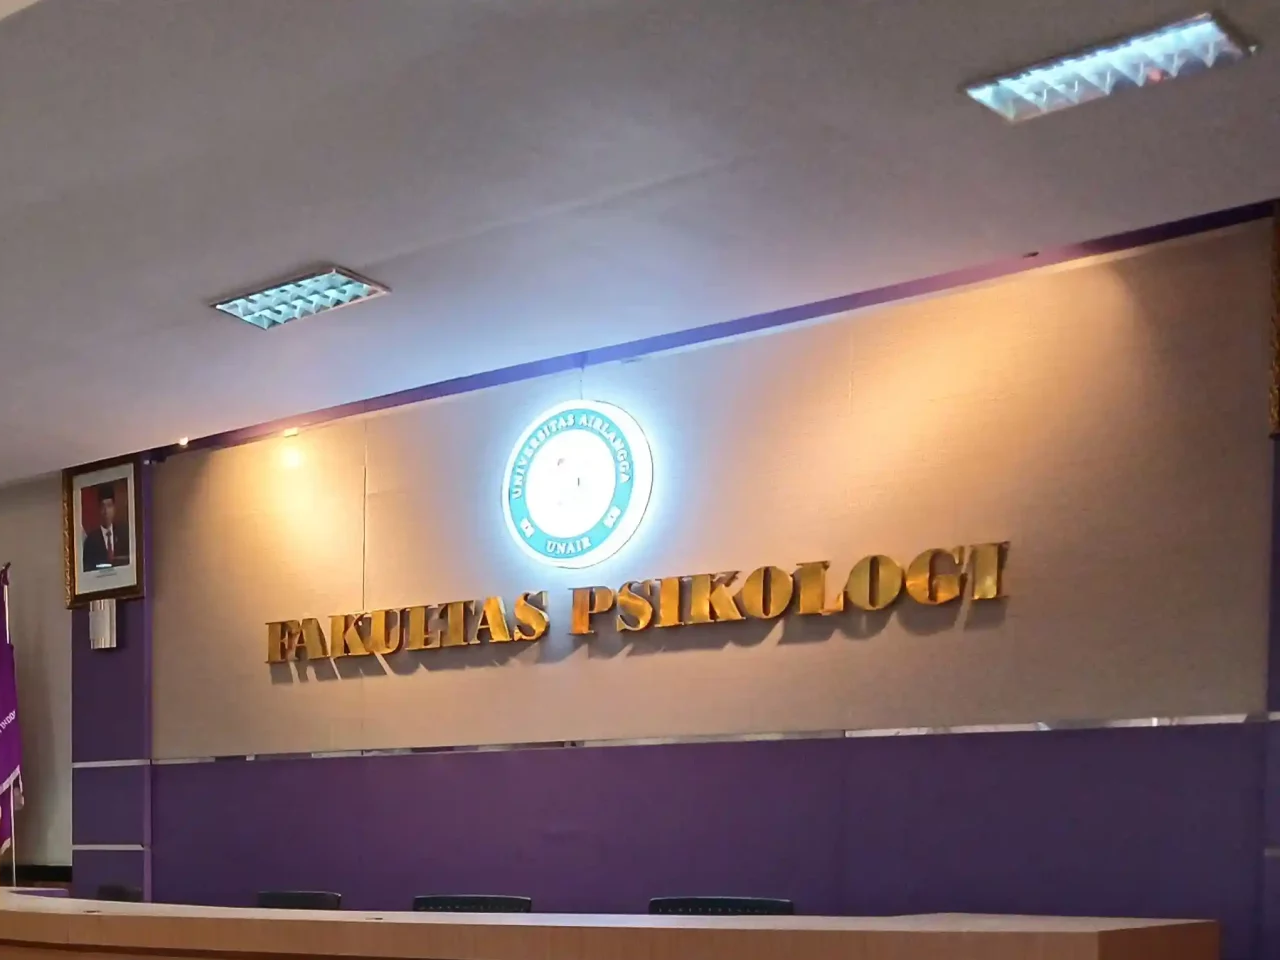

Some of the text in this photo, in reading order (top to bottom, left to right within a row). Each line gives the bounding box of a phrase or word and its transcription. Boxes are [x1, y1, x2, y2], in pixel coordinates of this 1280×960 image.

[512, 413, 631, 499] UNIVERSITAS AIRLANGGA
[546, 536, 592, 555] UNAIR
[265, 541, 1010, 664] FAKULTAS PSIKOLOGI
